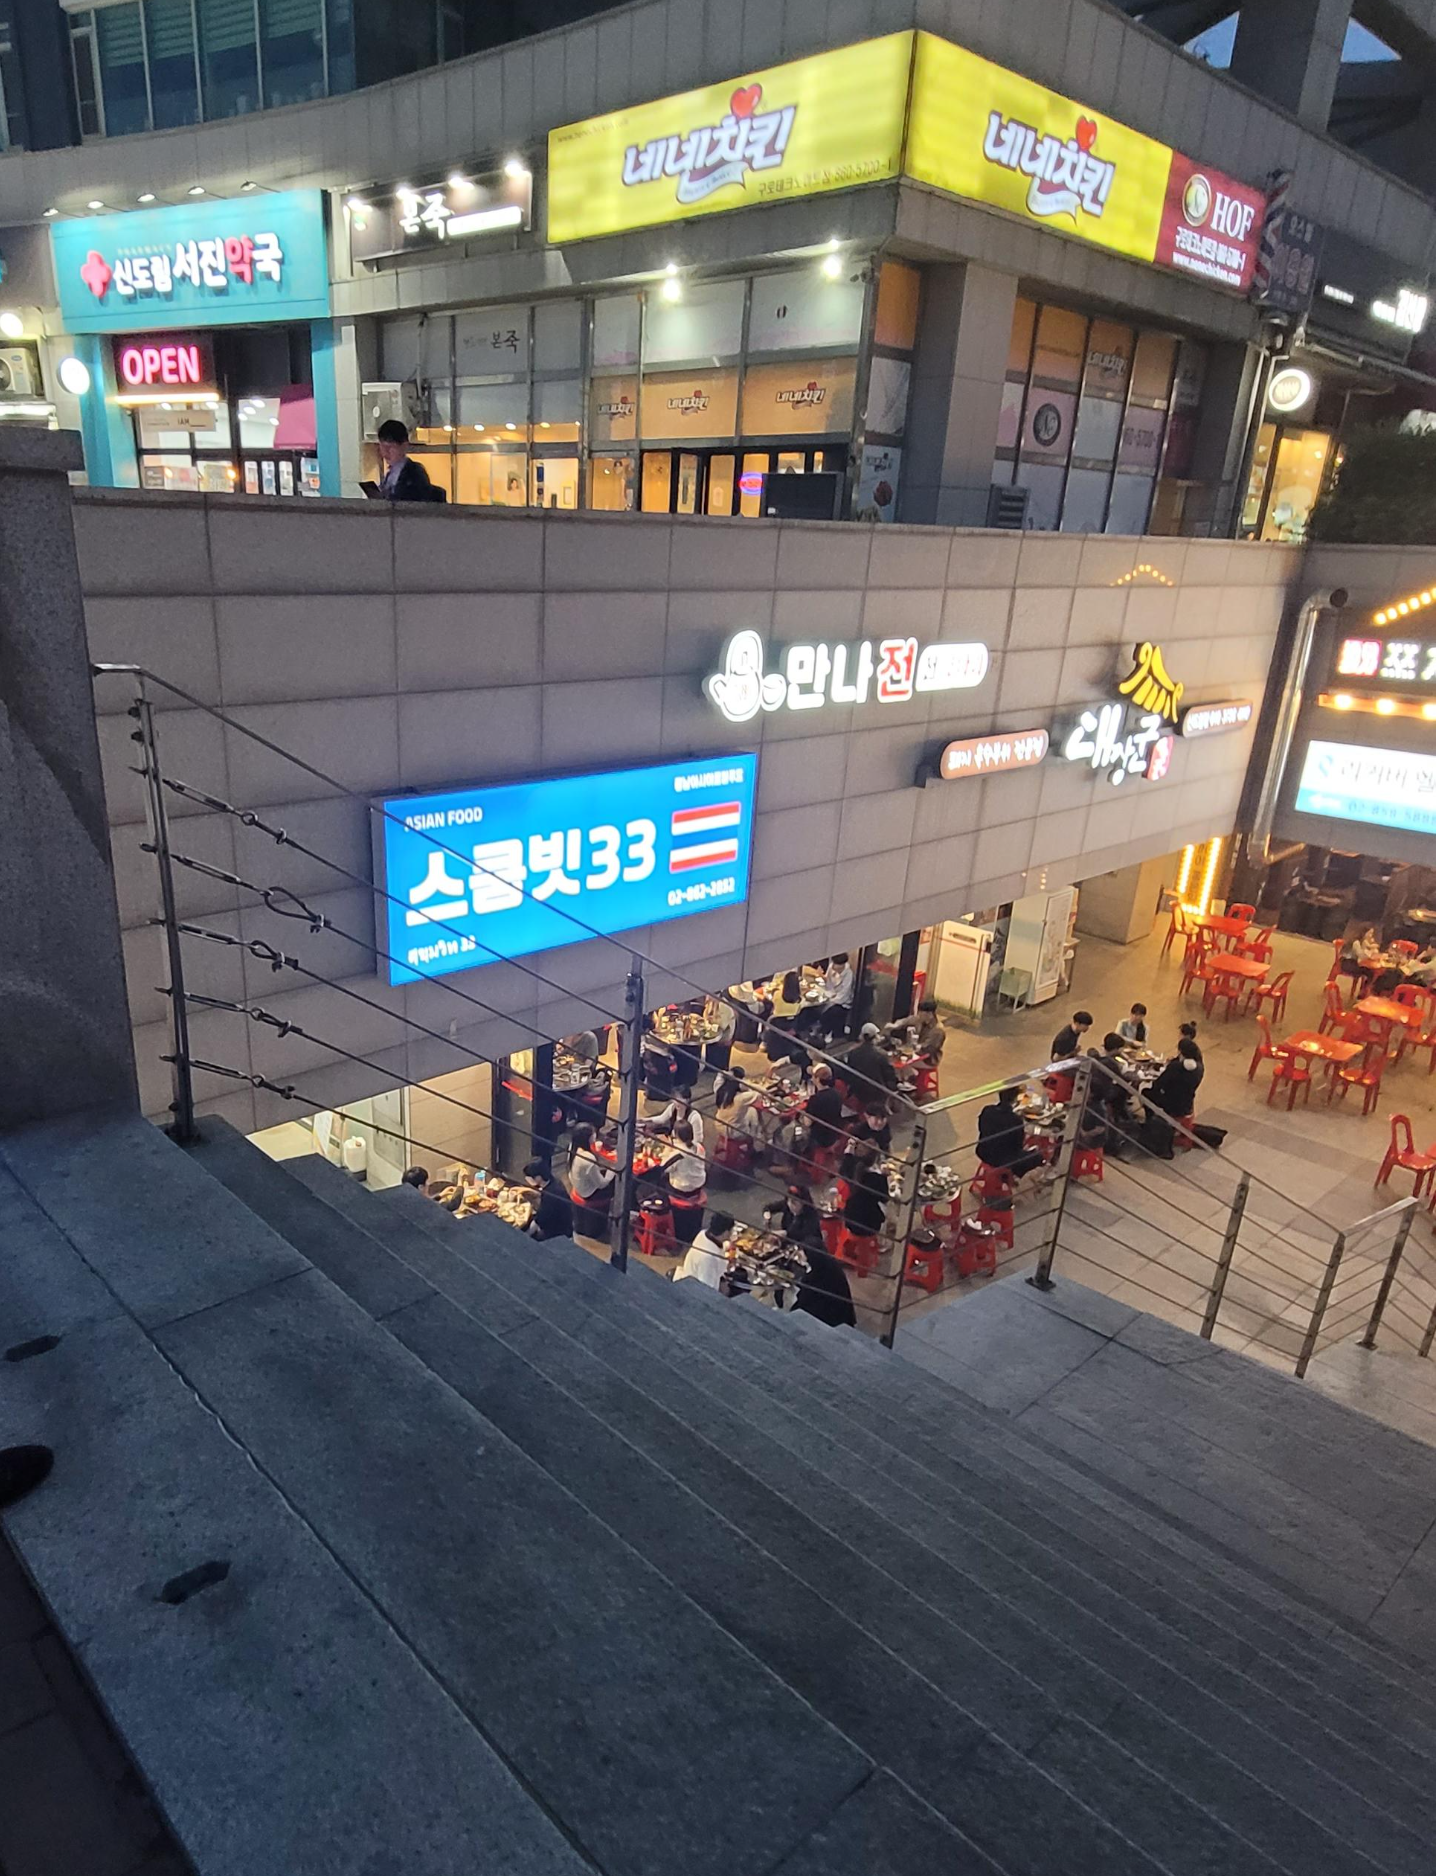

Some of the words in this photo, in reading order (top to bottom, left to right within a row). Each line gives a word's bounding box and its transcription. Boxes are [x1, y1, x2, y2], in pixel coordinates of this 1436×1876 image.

[622, 104, 797, 188] 네네치킨
[983, 110, 1117, 218] 네네치킨
[399, 192, 452, 240] 본죽
[1212, 191, 1255, 242] HOF
[112, 253, 173, 296] 신도림
[172, 232, 284, 287] 서진약국
[120, 344, 202, 387] OPEN
[490, 329, 522, 355] 본죽
[666, 393, 711, 412] 네네치킨
[774, 386, 827, 406] 네네치킨
[786, 636, 919, 710] 만나전
[1065, 703, 1161, 786] 대장군
[404, 808, 446, 833] ASIAN
[447, 805, 484, 829] FOOD
[405, 817, 658, 928] 스쿰빗33
